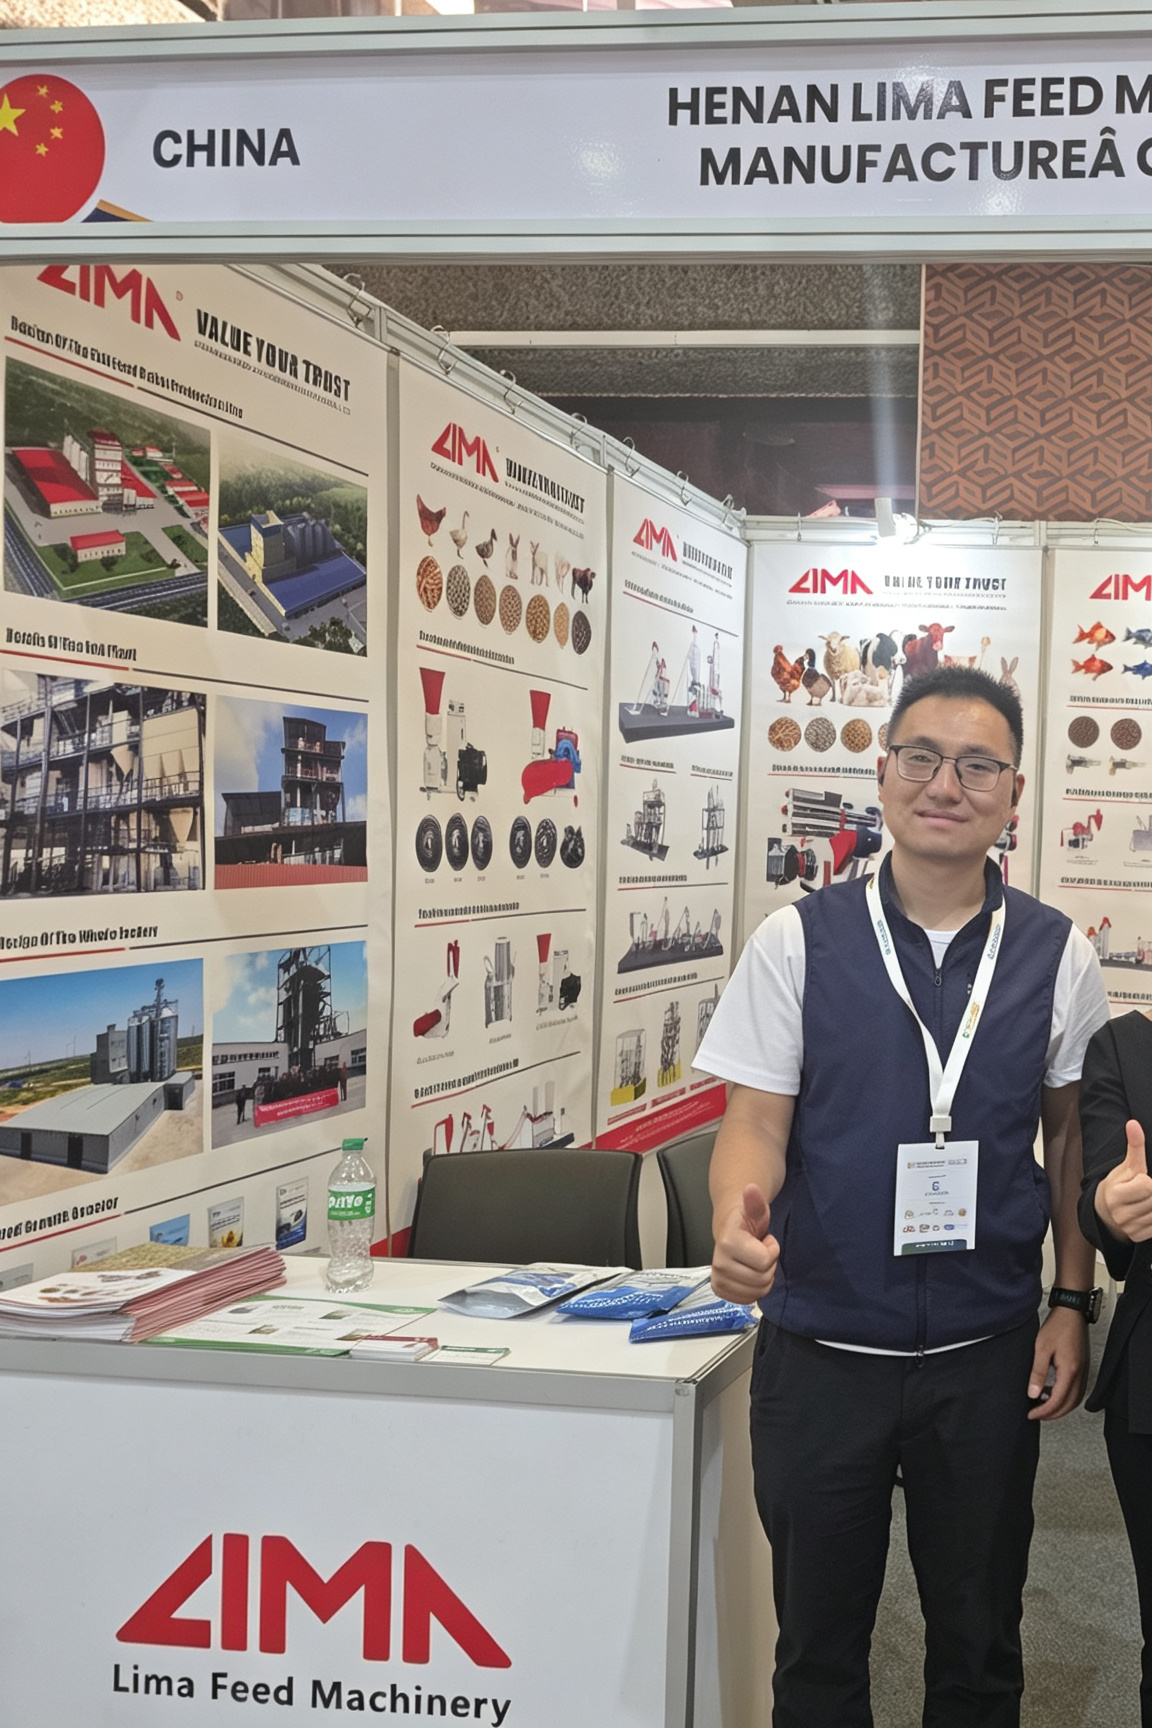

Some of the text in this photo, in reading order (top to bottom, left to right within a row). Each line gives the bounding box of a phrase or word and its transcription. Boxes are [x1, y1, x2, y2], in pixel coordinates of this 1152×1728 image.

[668, 84, 839, 126] HENAN
[852, 80, 973, 121] LIMA
[984, 76, 1103, 119] FEED
[152, 127, 301, 168] CHINA
[698, 125, 1124, 186] MANUFACTUREÂ
[196, 308, 252, 357] VALUE
[256, 337, 299, 380] YOUR
[302, 359, 351, 402] TRUST
[116, 1533, 512, 1669] LIMA
[113, 1663, 512, 1728] Lima Feed Machinery
